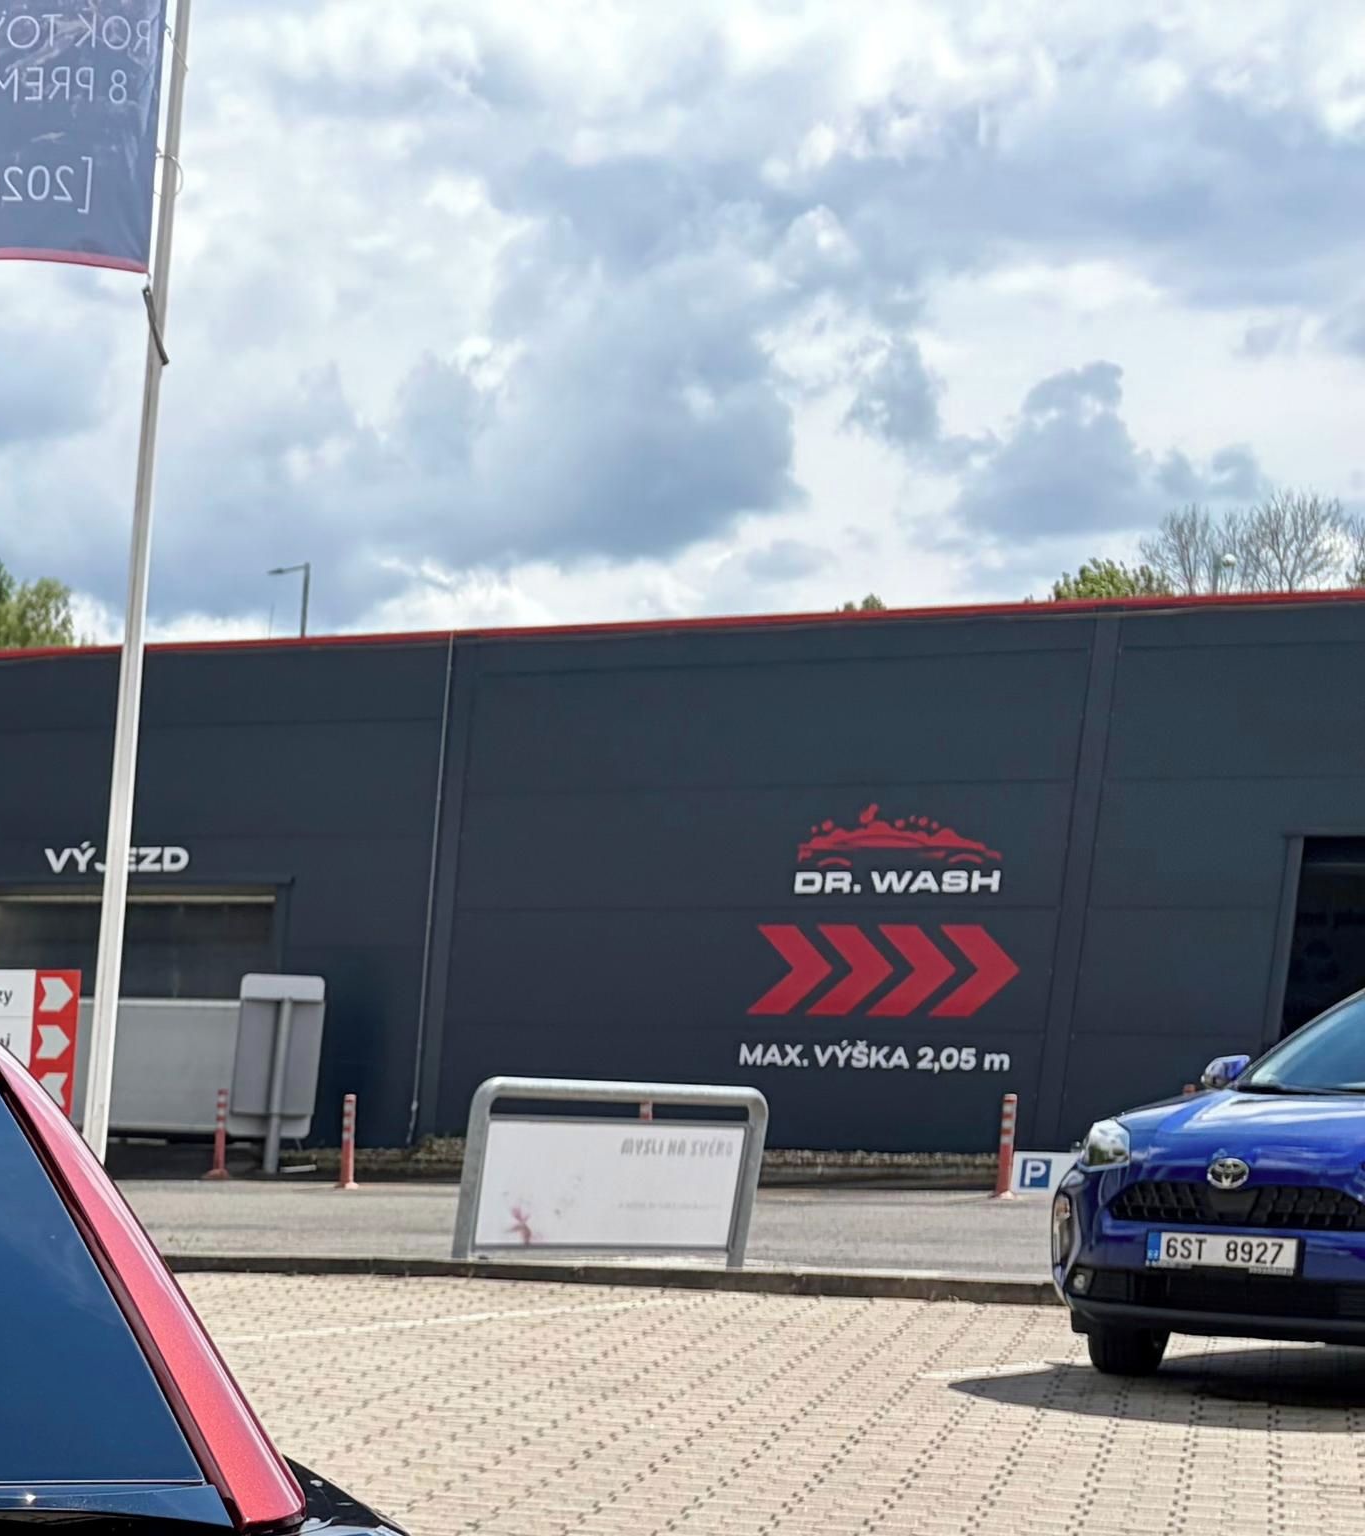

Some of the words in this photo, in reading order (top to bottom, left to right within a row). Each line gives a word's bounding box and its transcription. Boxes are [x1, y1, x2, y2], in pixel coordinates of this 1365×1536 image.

[793, 871, 862, 894] DR.
[871, 870, 1001, 893] WASH
[738, 1043, 809, 1067] MAX.
[813, 1040, 909, 1069] VÝŠKA
[916, 1046, 977, 1074] 2,05
[983, 1052, 1010, 1071] m
[1166, 1236, 1207, 1261] 6ST
[1225, 1240, 1284, 1265] 8927
